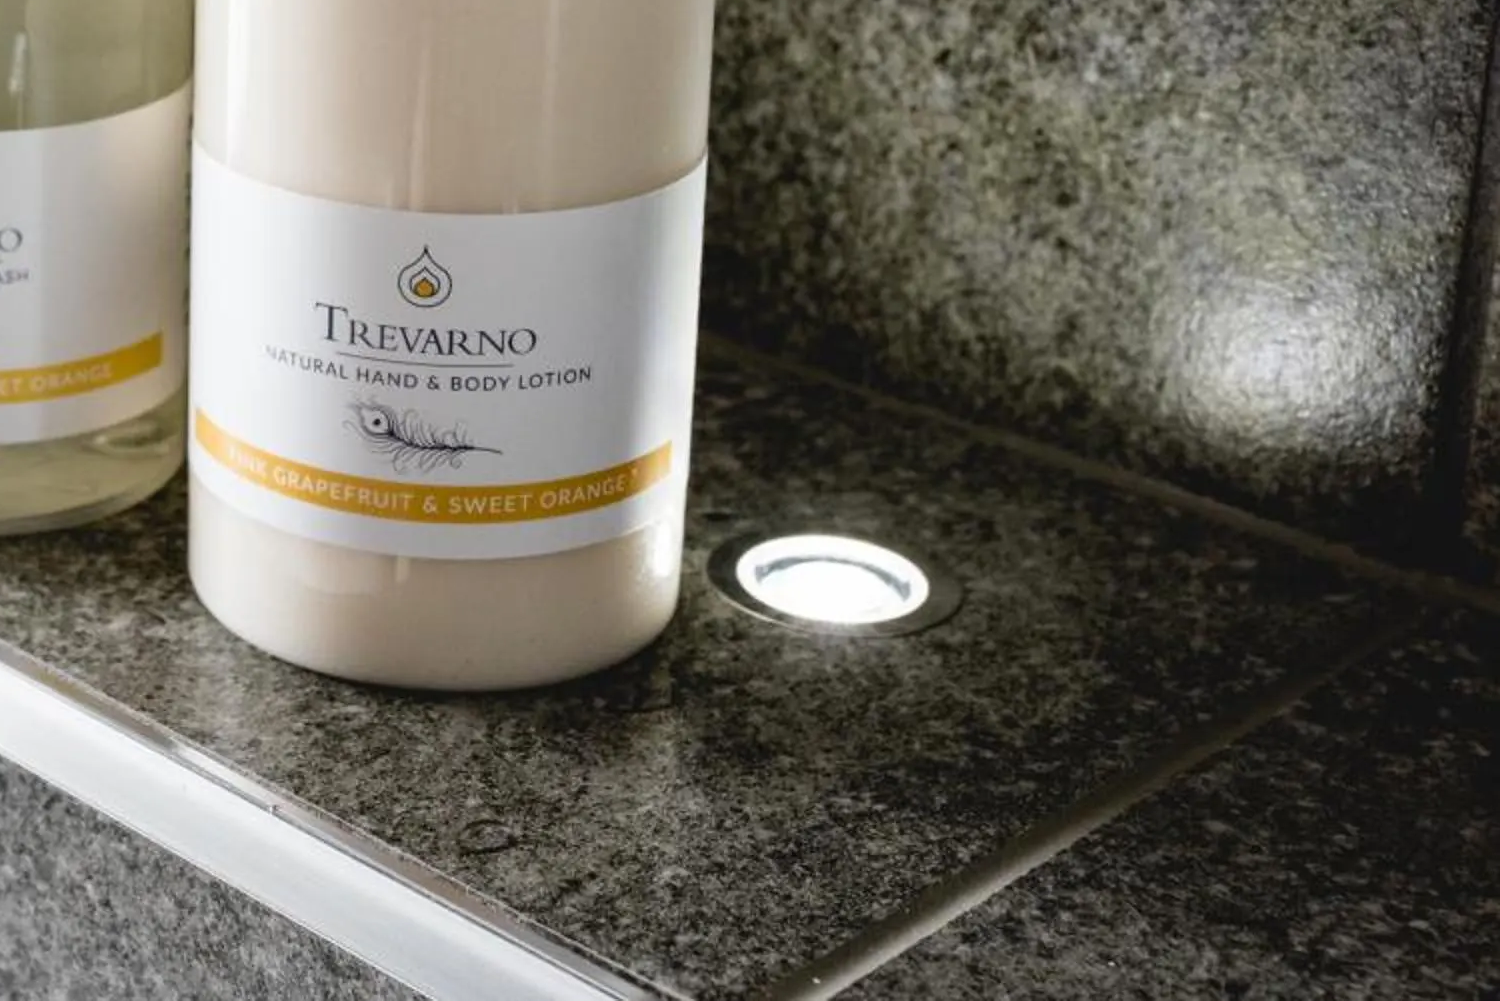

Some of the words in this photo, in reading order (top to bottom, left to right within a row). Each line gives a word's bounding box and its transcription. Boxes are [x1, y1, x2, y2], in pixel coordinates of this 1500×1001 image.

[315, 301, 537, 357] TREVARNO
[29, 362, 113, 393] ORANGE
[265, 344, 349, 380] NATURAL
[356, 365, 420, 390] HAND
[426, 374, 441, 390] &
[450, 375, 511, 392] BODY
[518, 366, 592, 391] LOTION
[273, 466, 415, 511] GRAPEFRUIT
[423, 494, 438, 514] &
[448, 493, 533, 515] SWEET
